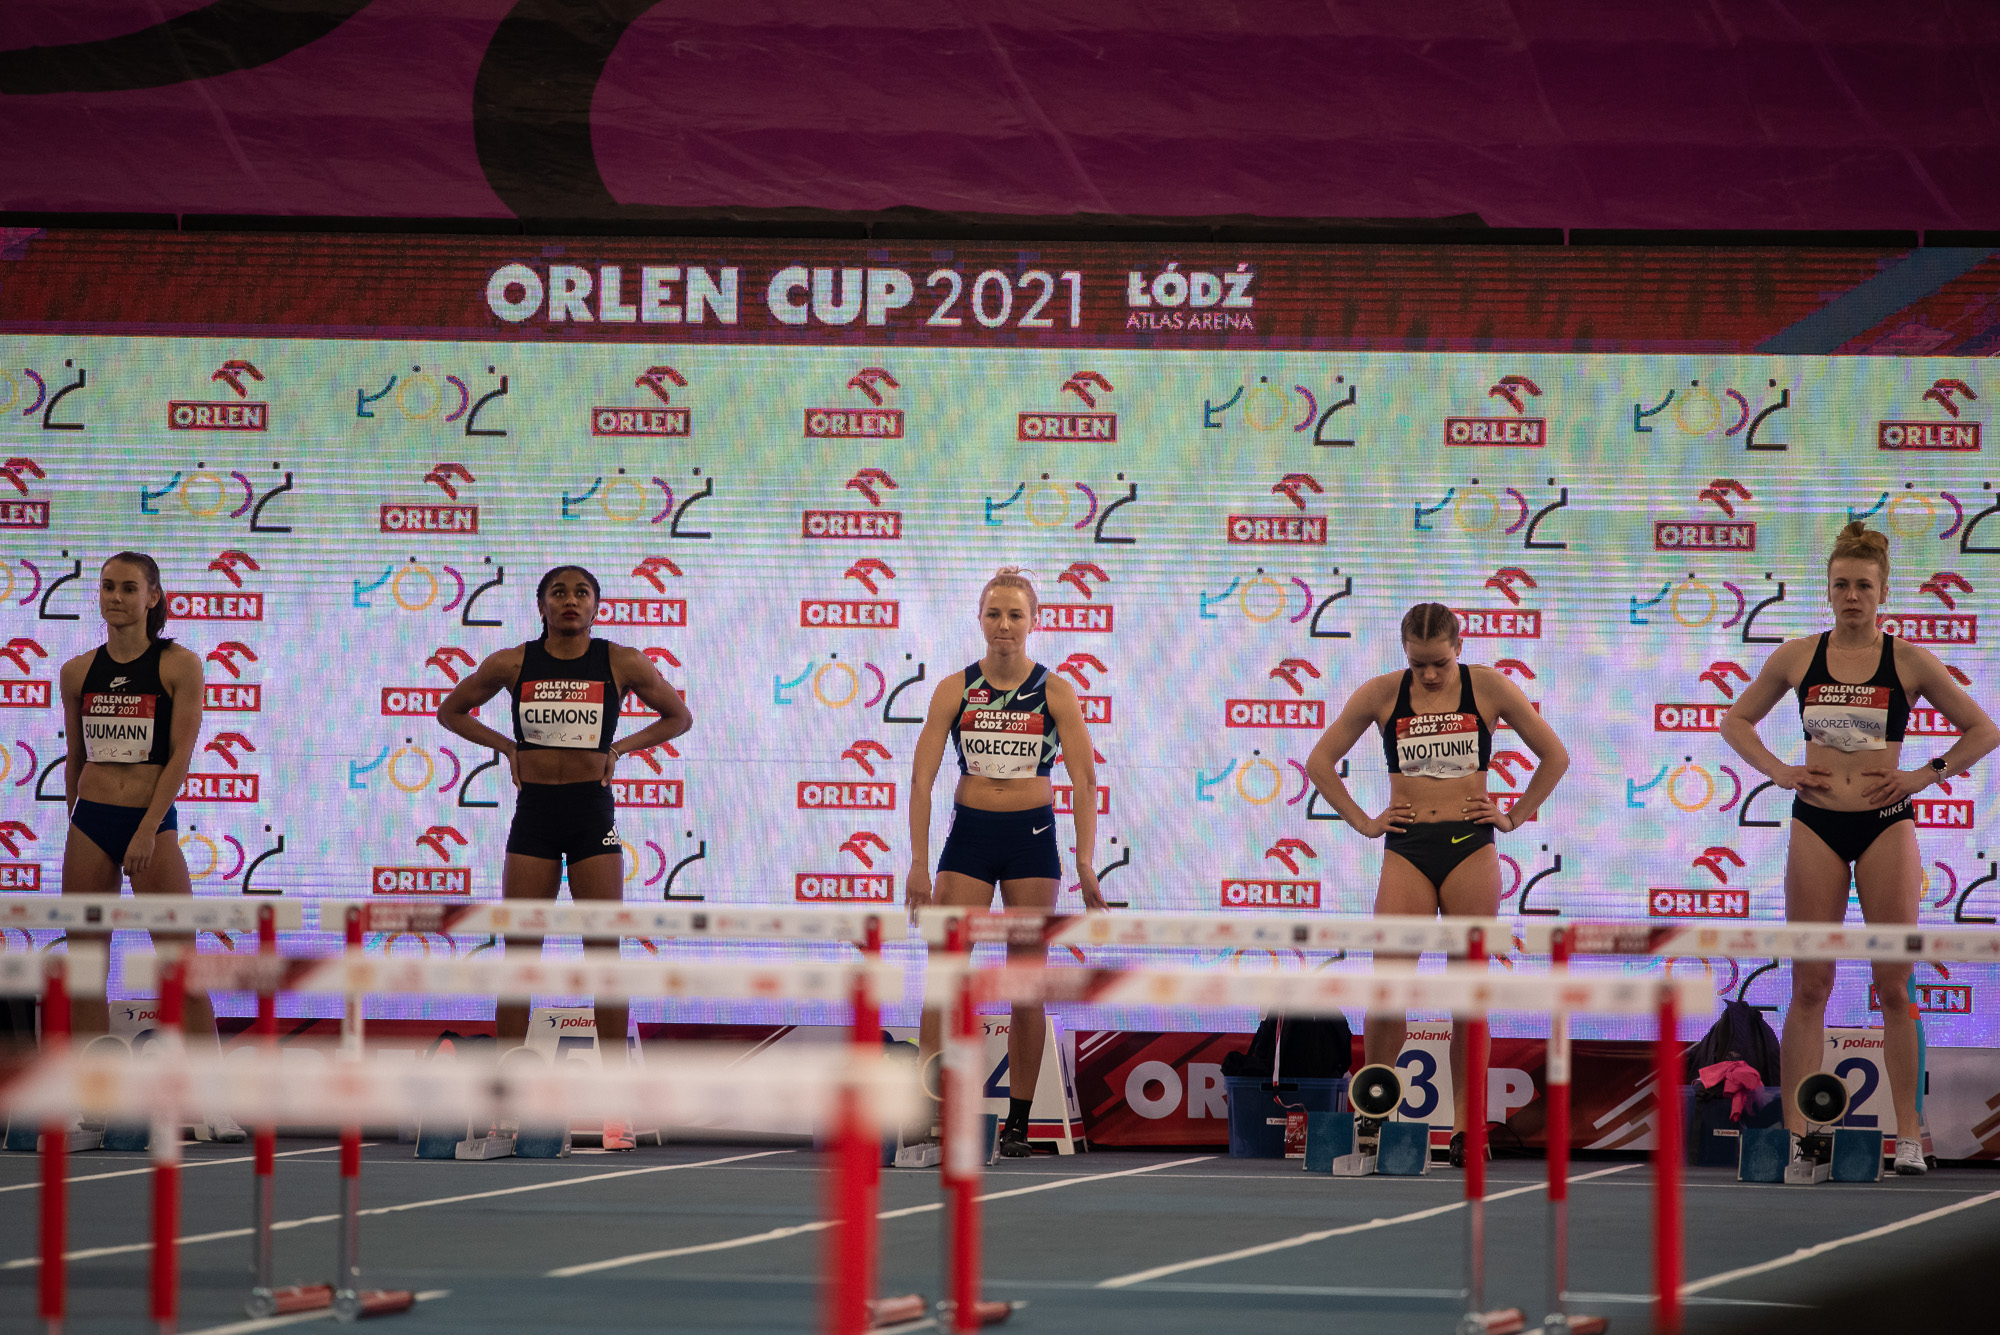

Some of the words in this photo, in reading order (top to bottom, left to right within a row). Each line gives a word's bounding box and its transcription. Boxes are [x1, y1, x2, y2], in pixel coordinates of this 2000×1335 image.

[486, 263, 740, 324] ORLEN
[767, 265, 914, 326] CUP
[925, 268, 1081, 328] 2021
[1126, 262, 1255, 309] ŁÓDŹ
[1126, 311, 1183, 331] ATLAS
[1188, 311, 1255, 331] ARENA
[173, 406, 262, 425] ORLEN
[596, 411, 685, 432] ORLEN
[809, 413, 898, 434] ORLEN
[1022, 417, 1111, 437] ORLEN
[1449, 422, 1541, 442] ORLEN
[1883, 426, 1976, 445] ORLEN
[385, 508, 473, 529] ORLEN
[807, 515, 896, 535] ORLEN
[1232, 518, 1322, 540] ORLEN
[1659, 525, 1750, 547] ORLEN
[169, 595, 257, 616] ORLEN
[597, 603, 681, 622] ORLEN
[805, 604, 893, 624] ORLEN
[1040, 608, 1107, 629] RLEN
[1882, 618, 1969, 637] ORLEN
[0, 684, 45, 703] LEN
[534, 689, 563, 699] ŁÓDŹ
[565, 691, 587, 700] 2021
[535, 681, 569, 690] ORLEN
[570, 681, 590, 691] CUP
[1819, 685, 1854, 694] ORLEN
[1854, 686, 1876, 694] CUP
[92, 695, 122, 704] ORLEN
[123, 695, 142, 705] CUP
[205, 687, 255, 707] LEN
[387, 692, 449, 712] ORL
[1818, 693, 1847, 703] ŁÓDŹ
[1849, 695, 1873, 705] 2021
[90, 703, 116, 714] ŁÓDŹ
[118, 705, 138, 715] 2021
[524, 708, 598, 725] CLEMONS
[975, 711, 1010, 720] ORLEN
[1010, 712, 1031, 721] CUP
[1231, 704, 1319, 724] ORLEN
[1409, 714, 1443, 725] ORLEN
[1444, 713, 1464, 722] CUP
[1659, 707, 1728, 728] ORLE
[85, 723, 147, 740] SUUMANN
[974, 719, 1003, 730] ŁÓDŹ
[1005, 722, 1027, 731] 2021
[1409, 723, 1438, 735] ŁÓDŹ
[1440, 722, 1462, 732] 2021
[1807, 717, 1881, 730] SKÓRZEWSKA
[1906, 711, 1957, 732] RLE
[965, 738, 1038, 757] KOŁECZEK
[1401, 739, 1474, 761] WOJTUNIK
[611, 783, 677, 805] RLEN
[801, 786, 890, 805] ORLEN
[1879, 802, 1904, 818] NIKE
[1917, 803, 1968, 825] LEN
[377, 871, 465, 891] ORLEN
[800, 878, 888, 898] ORLEN
[1226, 883, 1315, 904] ORLEN
[1653, 892, 1743, 912] ORLEN
[560, 1016, 597, 1029] polan
[1406, 1030, 1453, 1041] polanik
[1395, 1049, 1439, 1119] 3
[1831, 1057, 1880, 1128] 2
